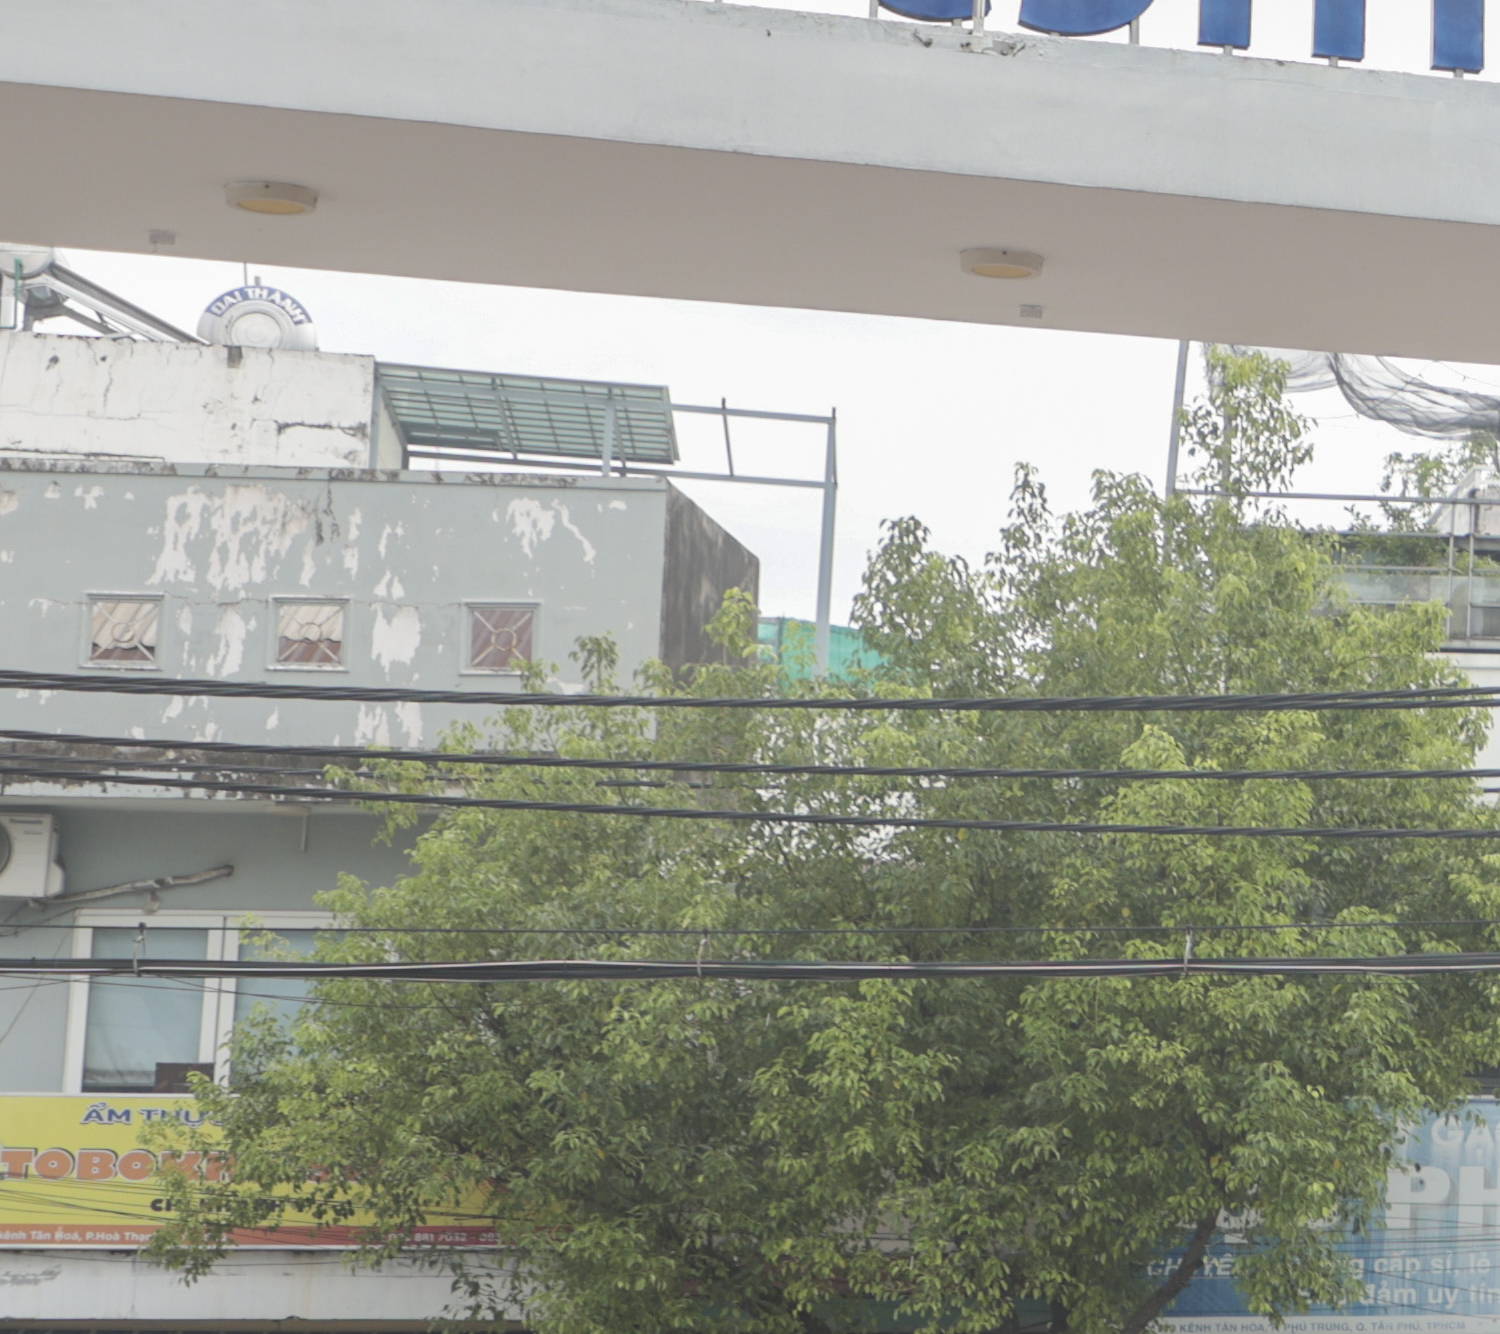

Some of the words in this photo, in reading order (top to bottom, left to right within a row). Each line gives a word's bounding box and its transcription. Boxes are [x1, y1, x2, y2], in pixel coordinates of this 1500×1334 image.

[80, 1102, 132, 1125] ẨM
[1359, 1280, 1417, 1305] đảm
[1427, 1286, 1460, 1309] uy
[1180, 1320, 1212, 1333] KÊNH
[1215, 1321, 1238, 1333] TÂN
[1371, 1320, 1394, 1332] TÂN
[1427, 1320, 1466, 1330] TPHCM
